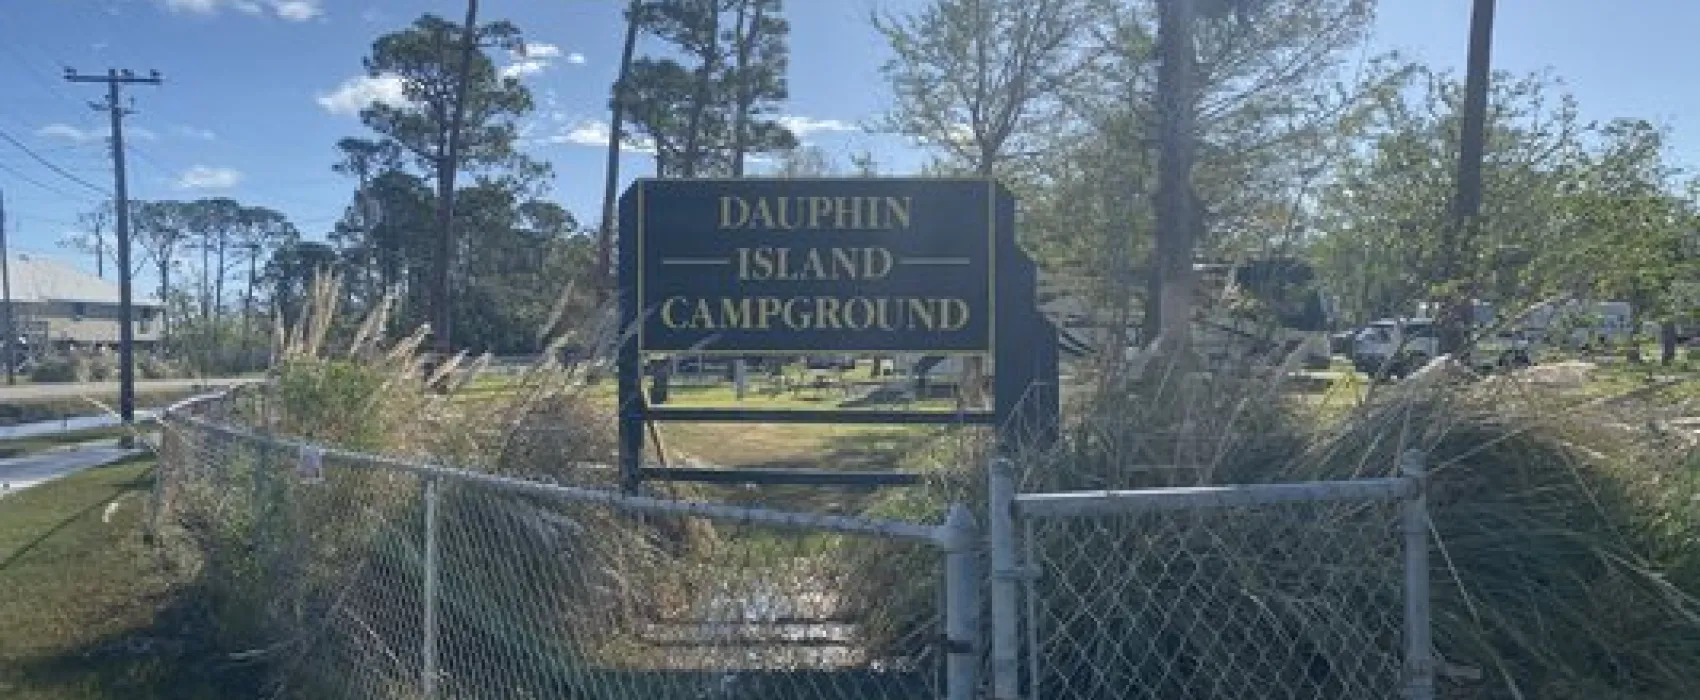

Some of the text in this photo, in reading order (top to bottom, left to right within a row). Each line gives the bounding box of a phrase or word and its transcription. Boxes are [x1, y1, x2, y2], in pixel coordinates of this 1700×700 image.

[718, 196, 912, 230] DAUPHIN
[737, 247, 894, 281] ISLAND
[660, 296, 970, 331] CAMPGROUND
